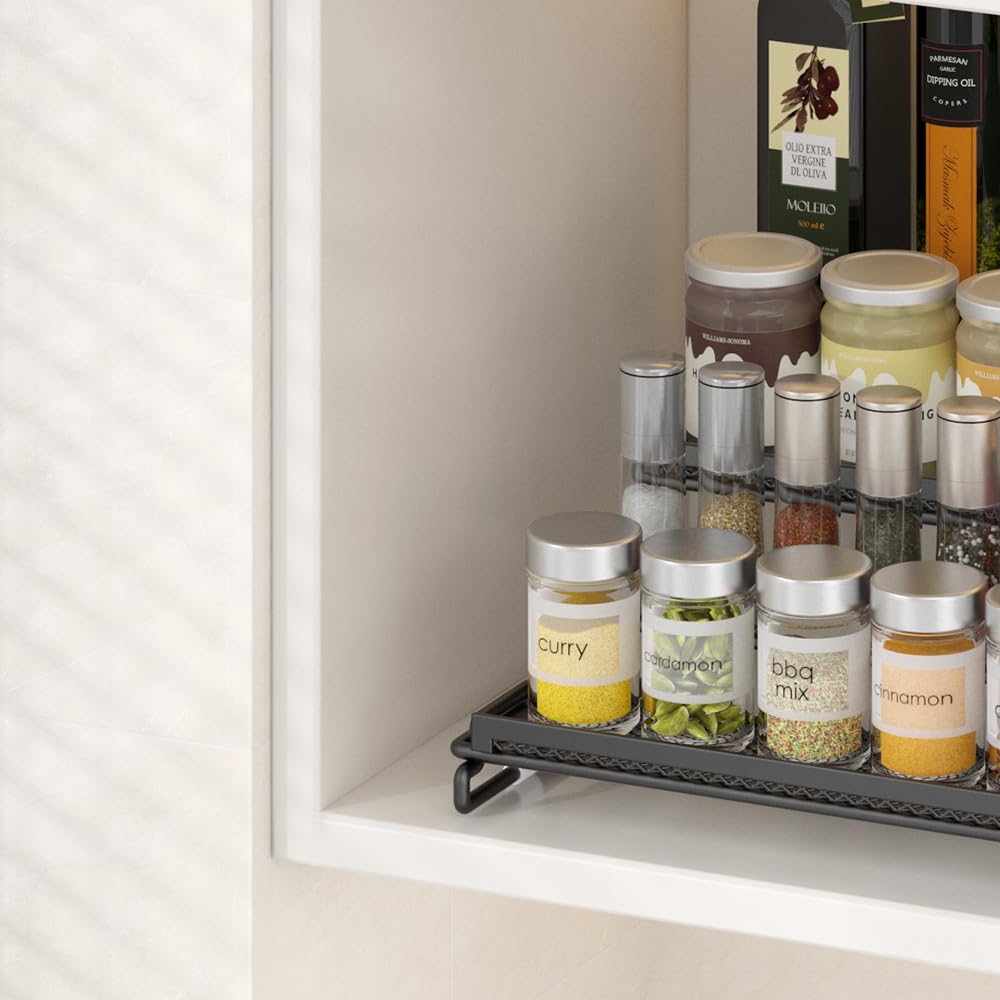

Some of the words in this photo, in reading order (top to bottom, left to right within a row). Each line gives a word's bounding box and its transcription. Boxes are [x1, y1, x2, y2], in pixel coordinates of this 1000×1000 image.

[929, 55, 968, 66] PARMESAN
[926, 74, 959, 87] DIPPING
[960, 78, 976, 88] OIL
[785, 141, 804, 154] OLIO
[806, 144, 832, 157] EXTRA
[792, 154, 826, 168] VERGINE
[802, 167, 827, 180] OLIVA
[537, 637, 588, 660] curry
[644, 650, 723, 673] cardamon
[771, 657, 814, 684] bbq
[775, 682, 809, 702] mix
[873, 681, 953, 706] cinnamon
